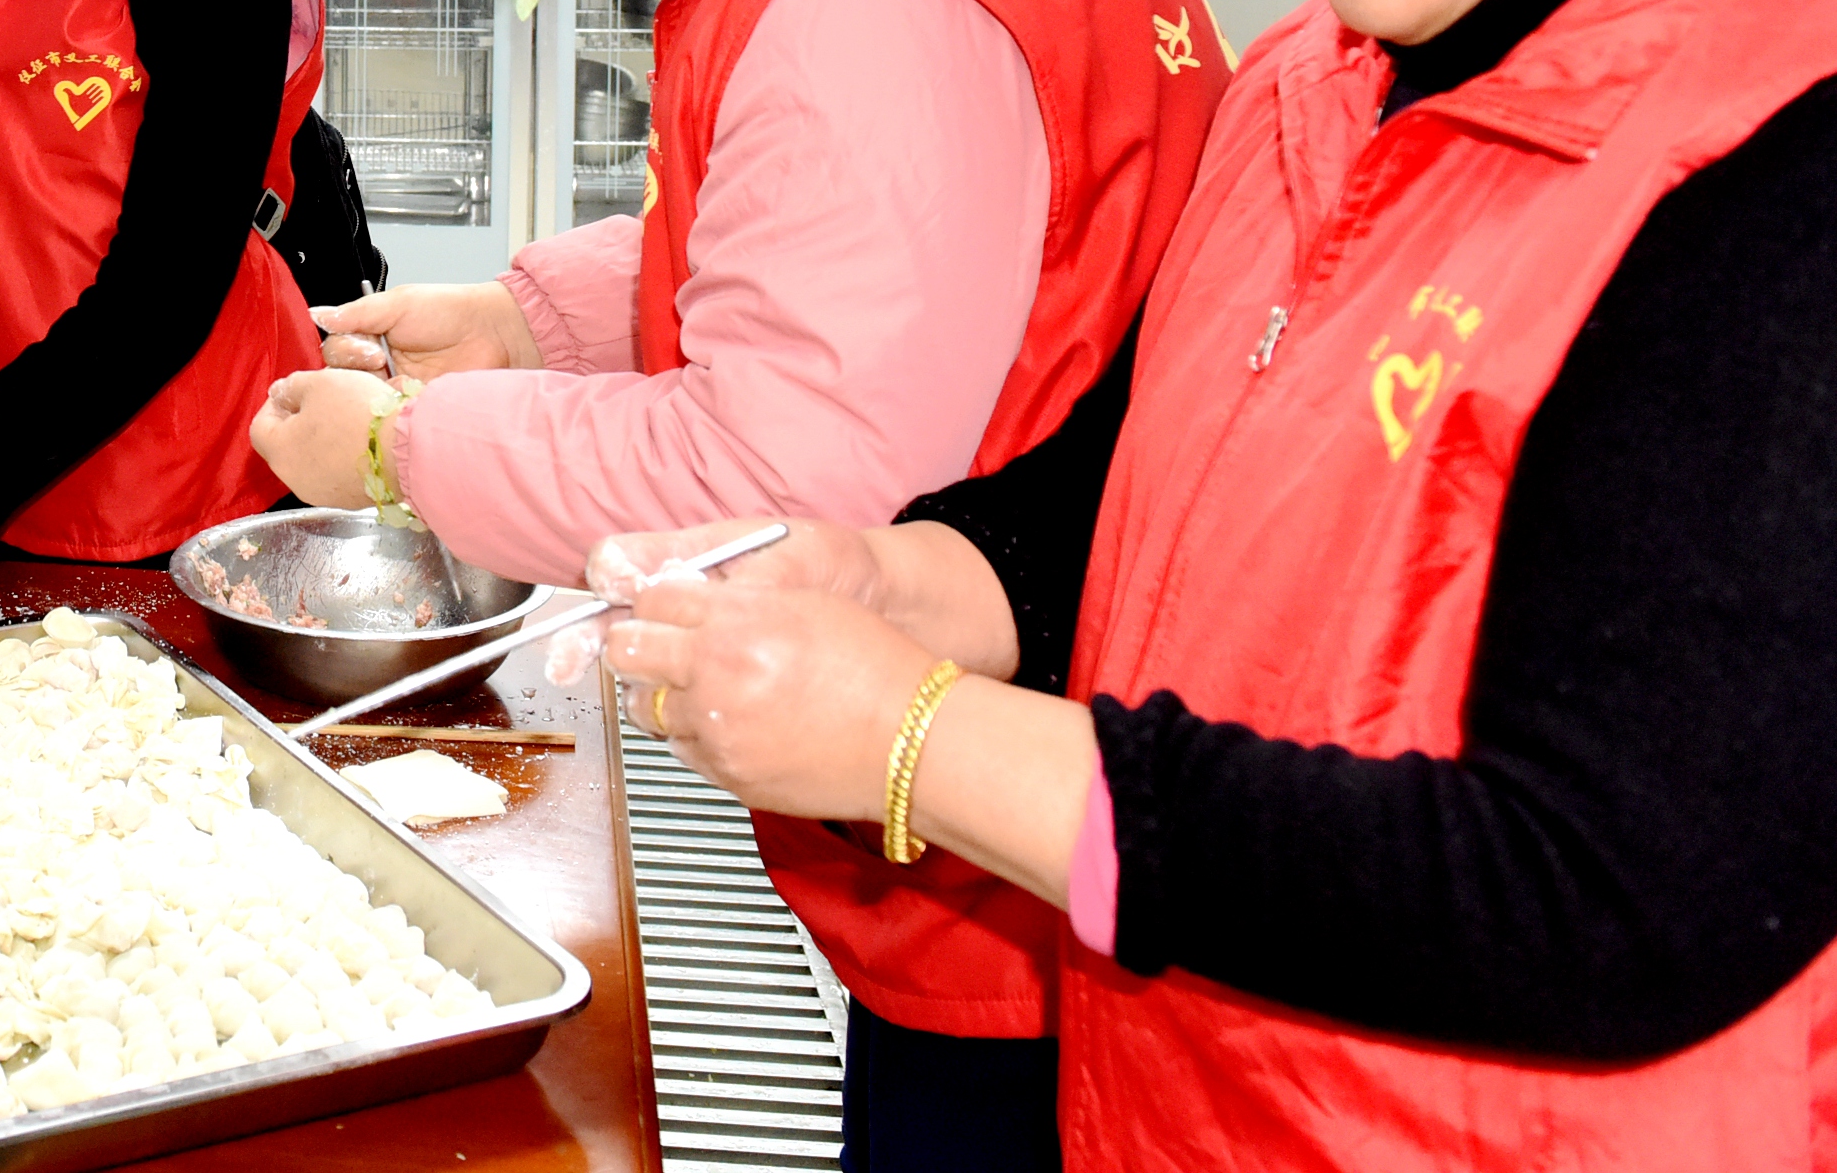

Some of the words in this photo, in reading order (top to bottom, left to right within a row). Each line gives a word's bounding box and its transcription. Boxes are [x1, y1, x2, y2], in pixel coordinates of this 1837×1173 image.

[18, 51, 142, 94] 仪征市义工联合会
